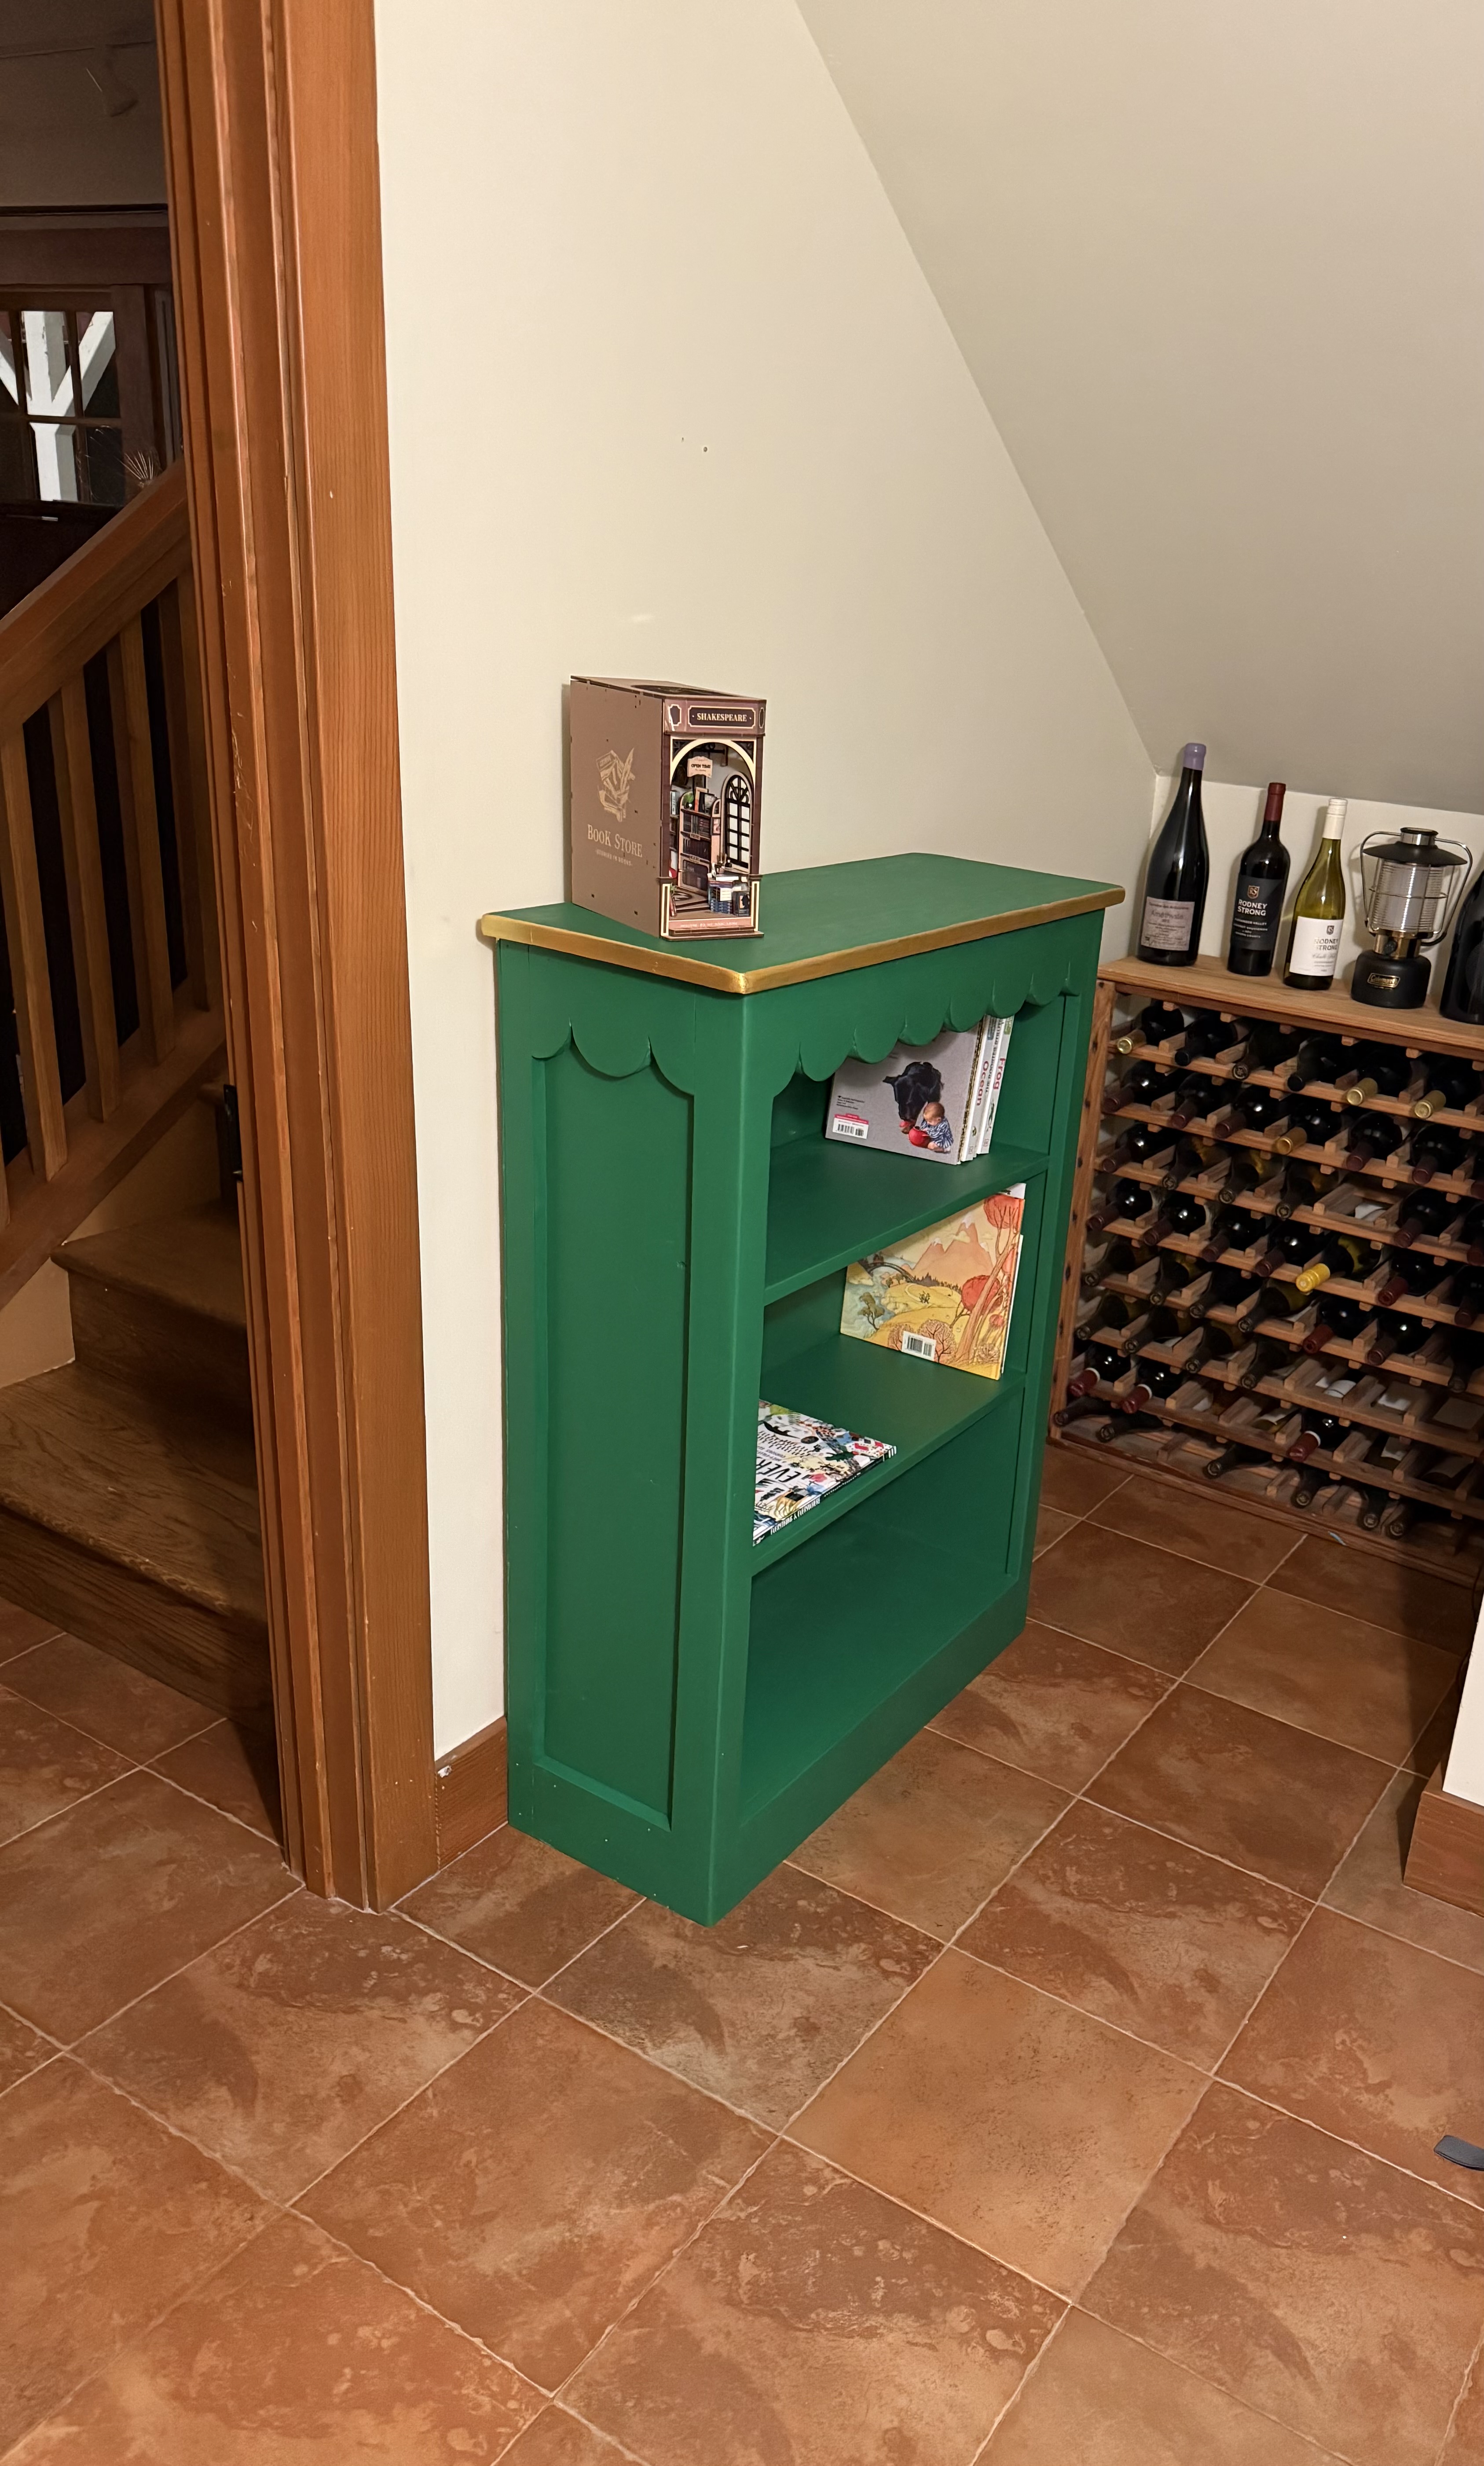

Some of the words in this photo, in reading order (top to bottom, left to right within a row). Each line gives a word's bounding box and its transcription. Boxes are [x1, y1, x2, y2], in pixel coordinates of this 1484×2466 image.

[696, 712, 747, 722] SHAKESPEARE
[587, 824, 611, 847] BOOK
[614, 834, 642, 858] STORE
[1238, 899, 1268, 910] RODNEY
[1238, 906, 1266, 916] STRONG
[977, 1061, 989, 1106] Ocean
[993, 1058, 1006, 1089] Frog
